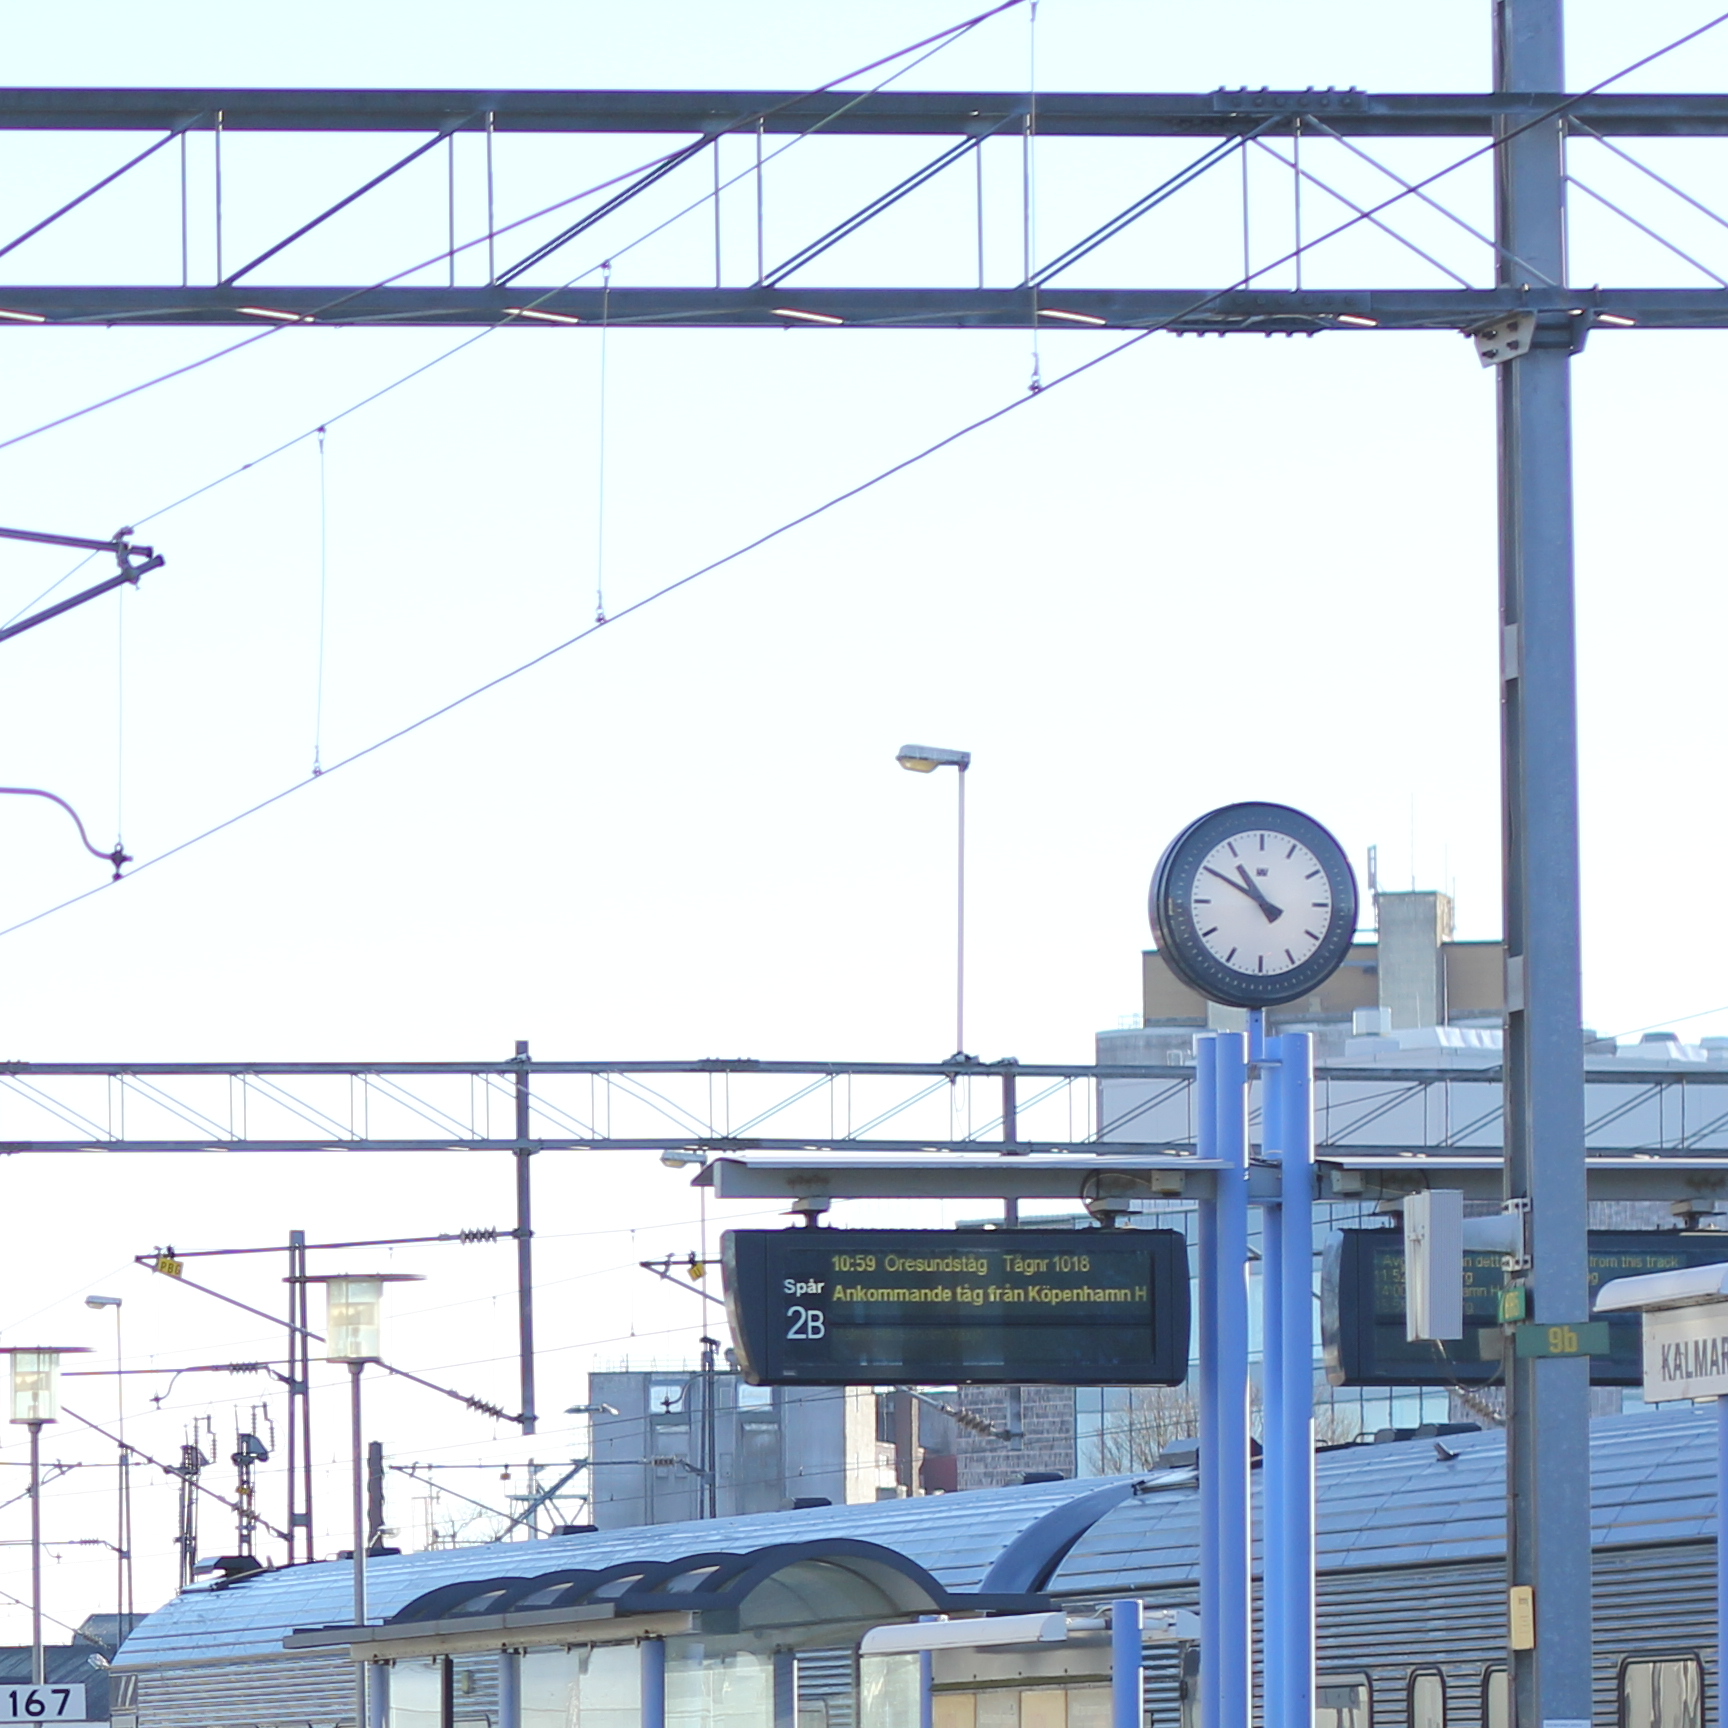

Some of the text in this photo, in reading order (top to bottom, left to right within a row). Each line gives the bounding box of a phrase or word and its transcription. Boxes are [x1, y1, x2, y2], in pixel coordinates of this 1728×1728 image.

[831, 1254, 876, 1273] 10:59
[1004, 1253, 1049, 1275] Tågnr
[1053, 1255, 1090, 1273] 1018
[783, 1277, 825, 1299] Spår
[833, 1283, 1147, 1306] Ankommande tåg från Köpenhamn H
[786, 1305, 825, 1340] 2B
[1548, 1324, 1579, 1354] 9b
[8, 1689, 72, 1718] 167
